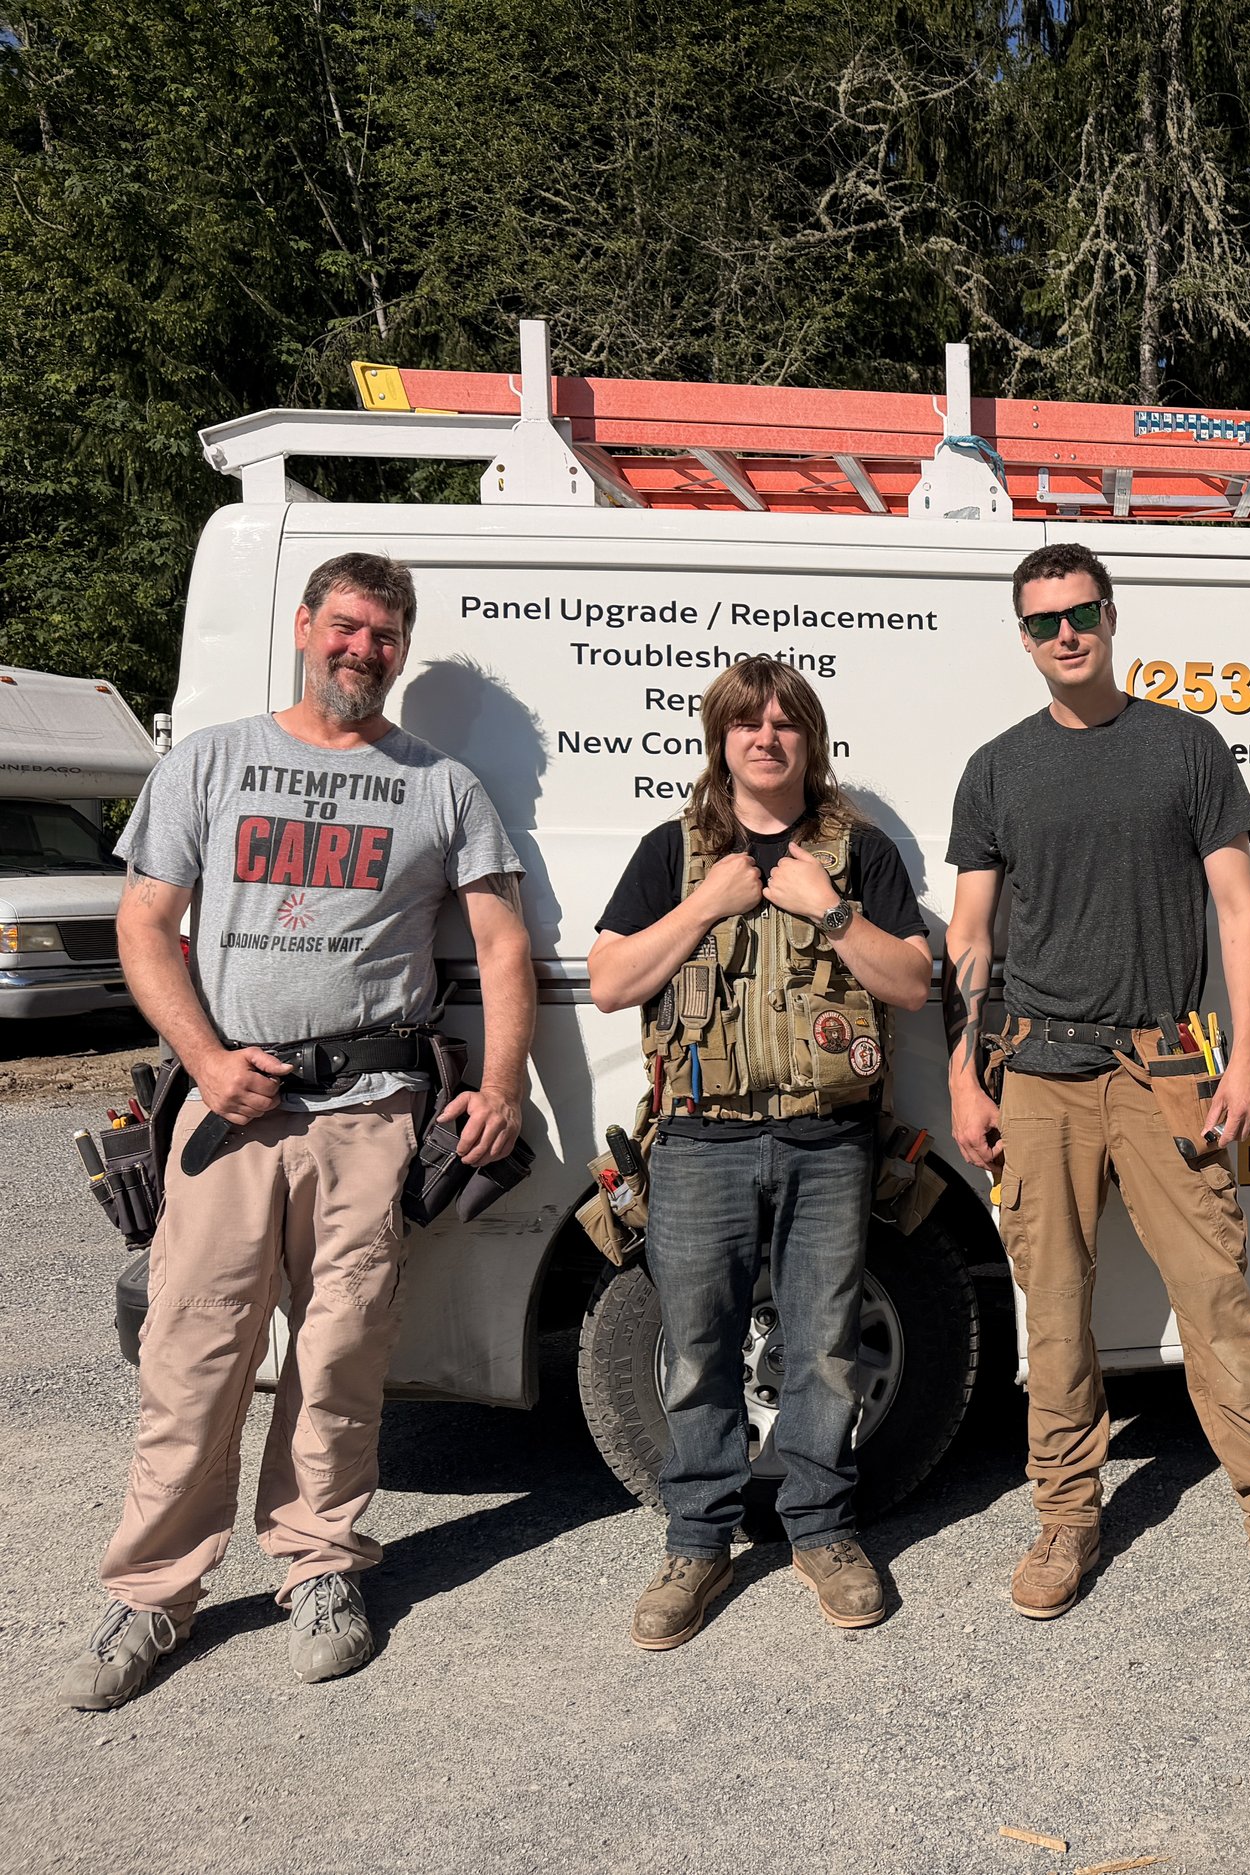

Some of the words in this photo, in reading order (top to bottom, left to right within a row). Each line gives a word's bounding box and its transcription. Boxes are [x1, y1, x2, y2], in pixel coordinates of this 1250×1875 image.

[460, 595, 551, 620] Panel
[560, 598, 699, 629] Upgrade
[707, 600, 723, 630] /
[731, 603, 938, 632] Replacement
[557, 730, 633, 754] New
[240, 765, 406, 805] ATTEMPTING
[303, 800, 338, 820] TO
[236, 816, 388, 889] CARE
[220, 931, 269, 950] LOADING
[270, 935, 324, 953] PLEASE
[614, 1357, 664, 1470] ADVANTA
